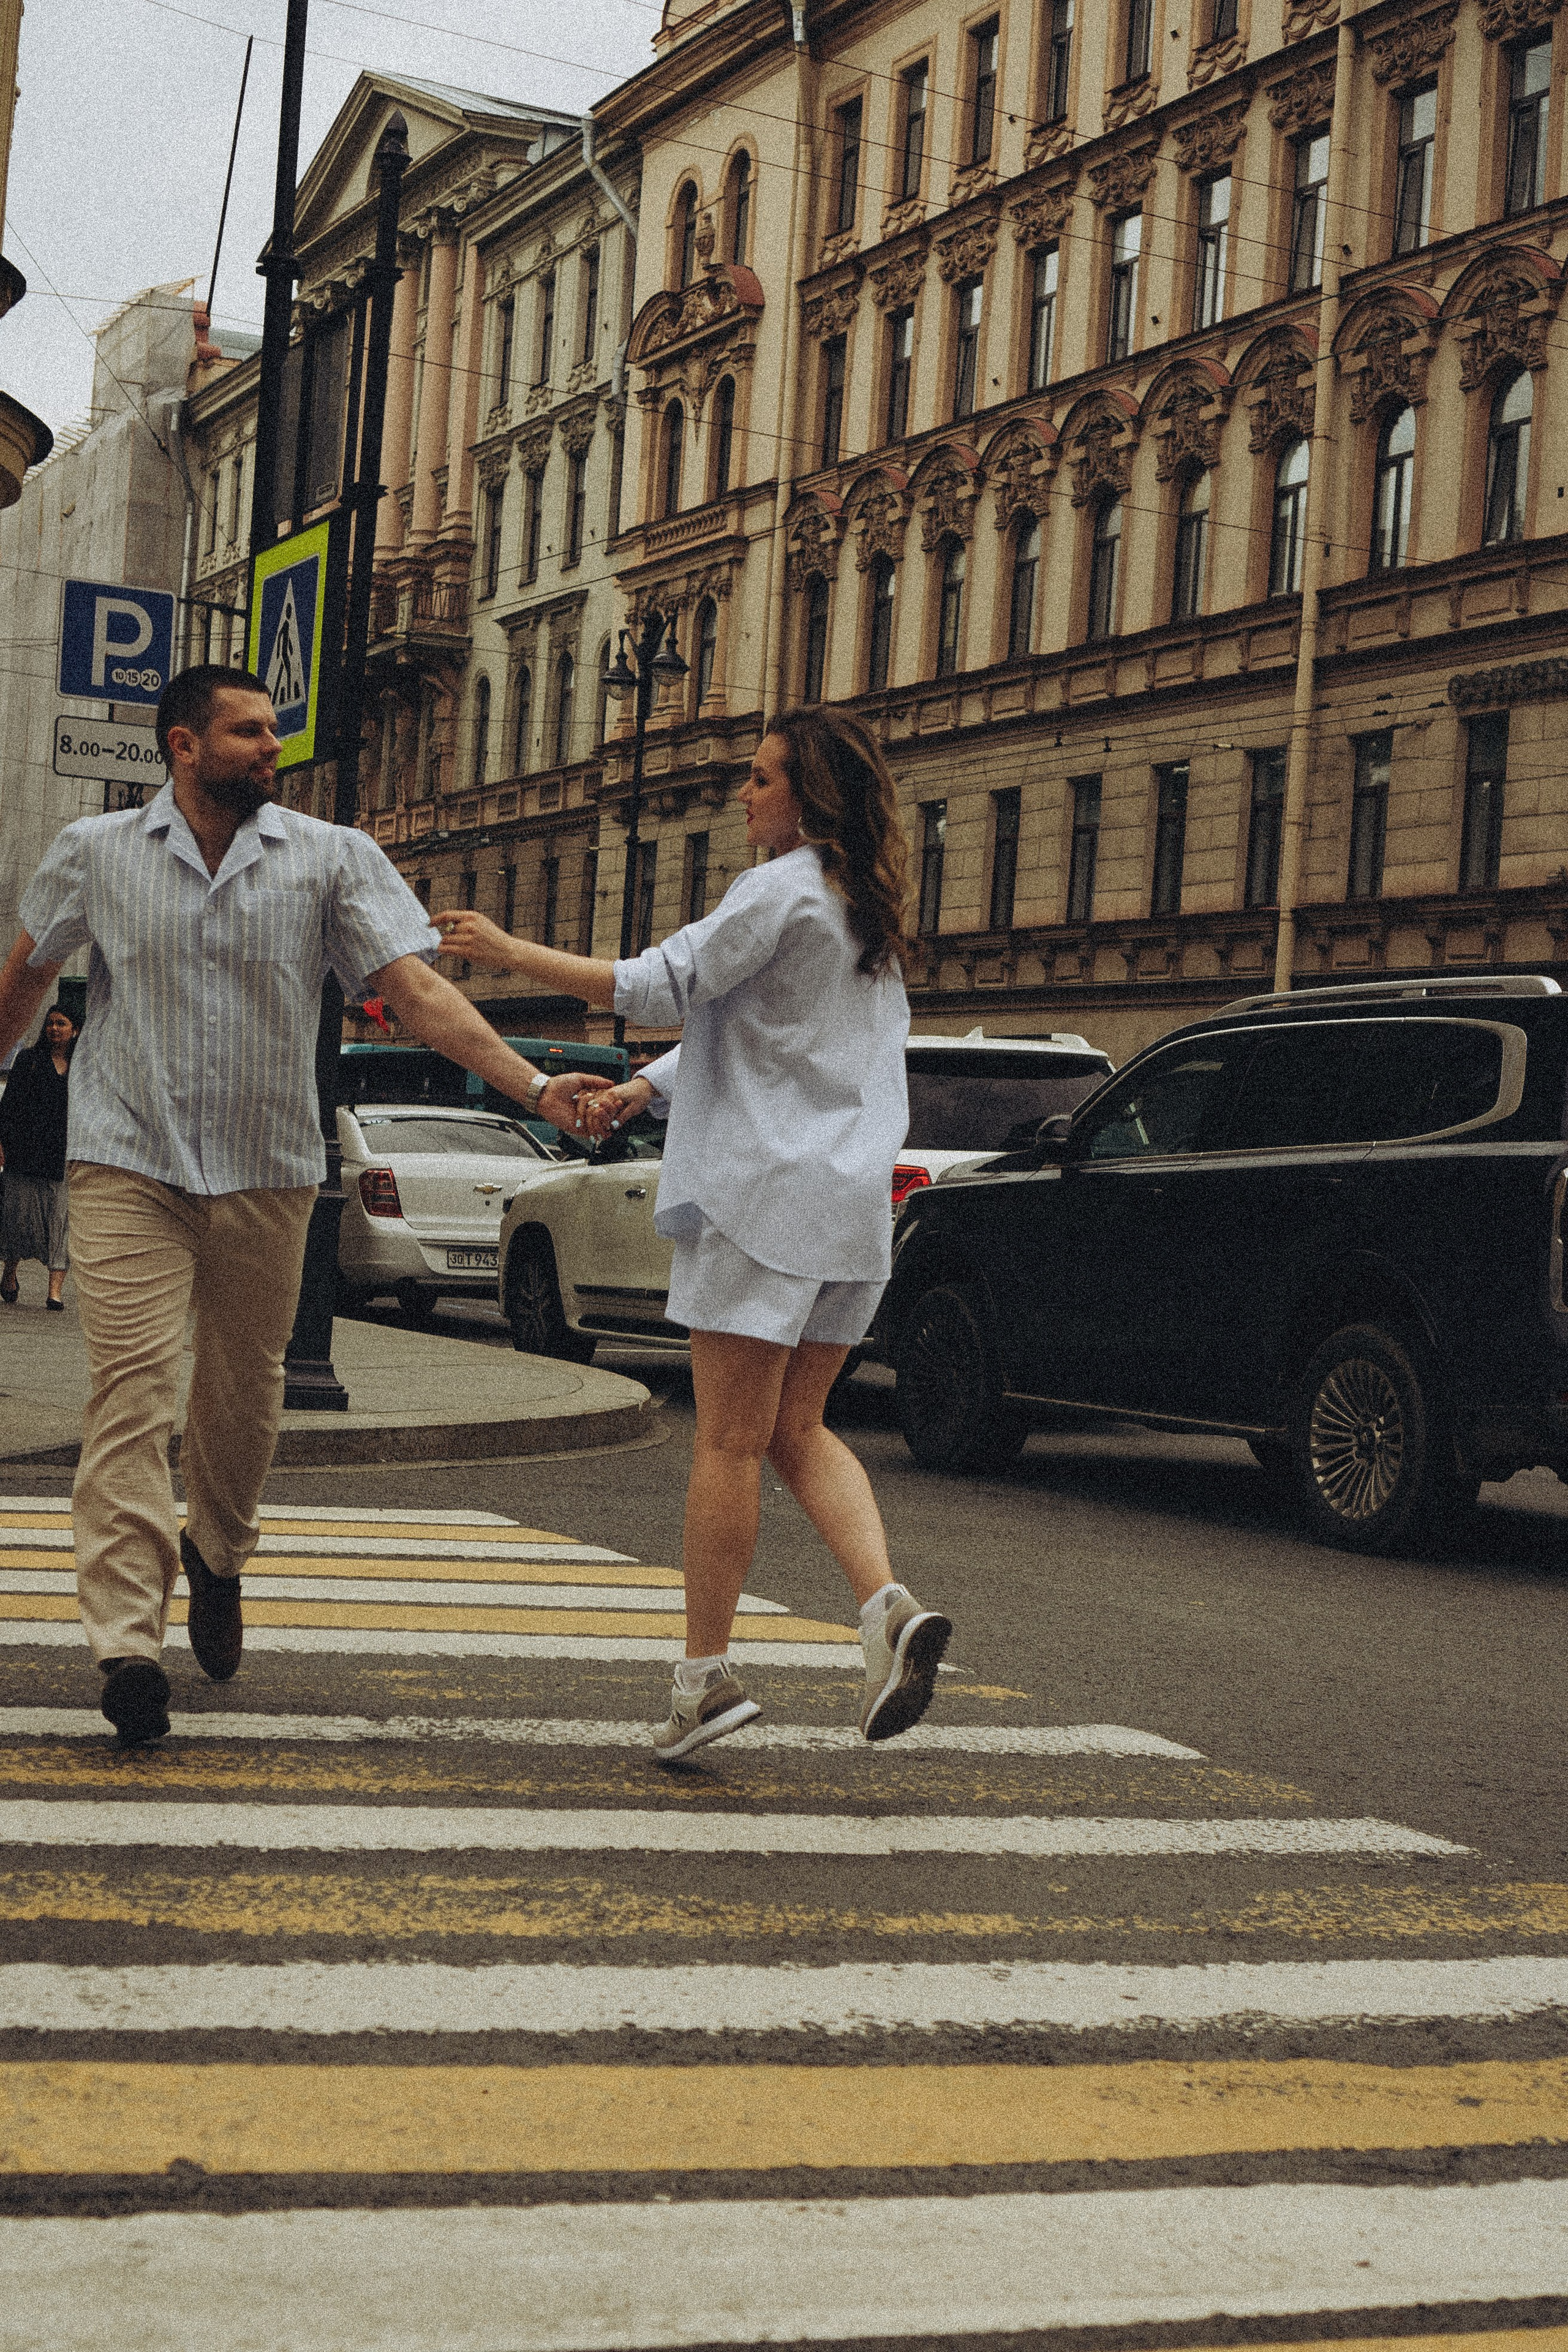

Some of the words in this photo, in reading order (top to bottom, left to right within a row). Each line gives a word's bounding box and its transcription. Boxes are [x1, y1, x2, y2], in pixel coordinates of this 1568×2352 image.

[92, 596, 153, 687] P
[115, 671, 124, 681] 10
[128, 672, 138, 684] 15
[142, 673, 159, 687] 20
